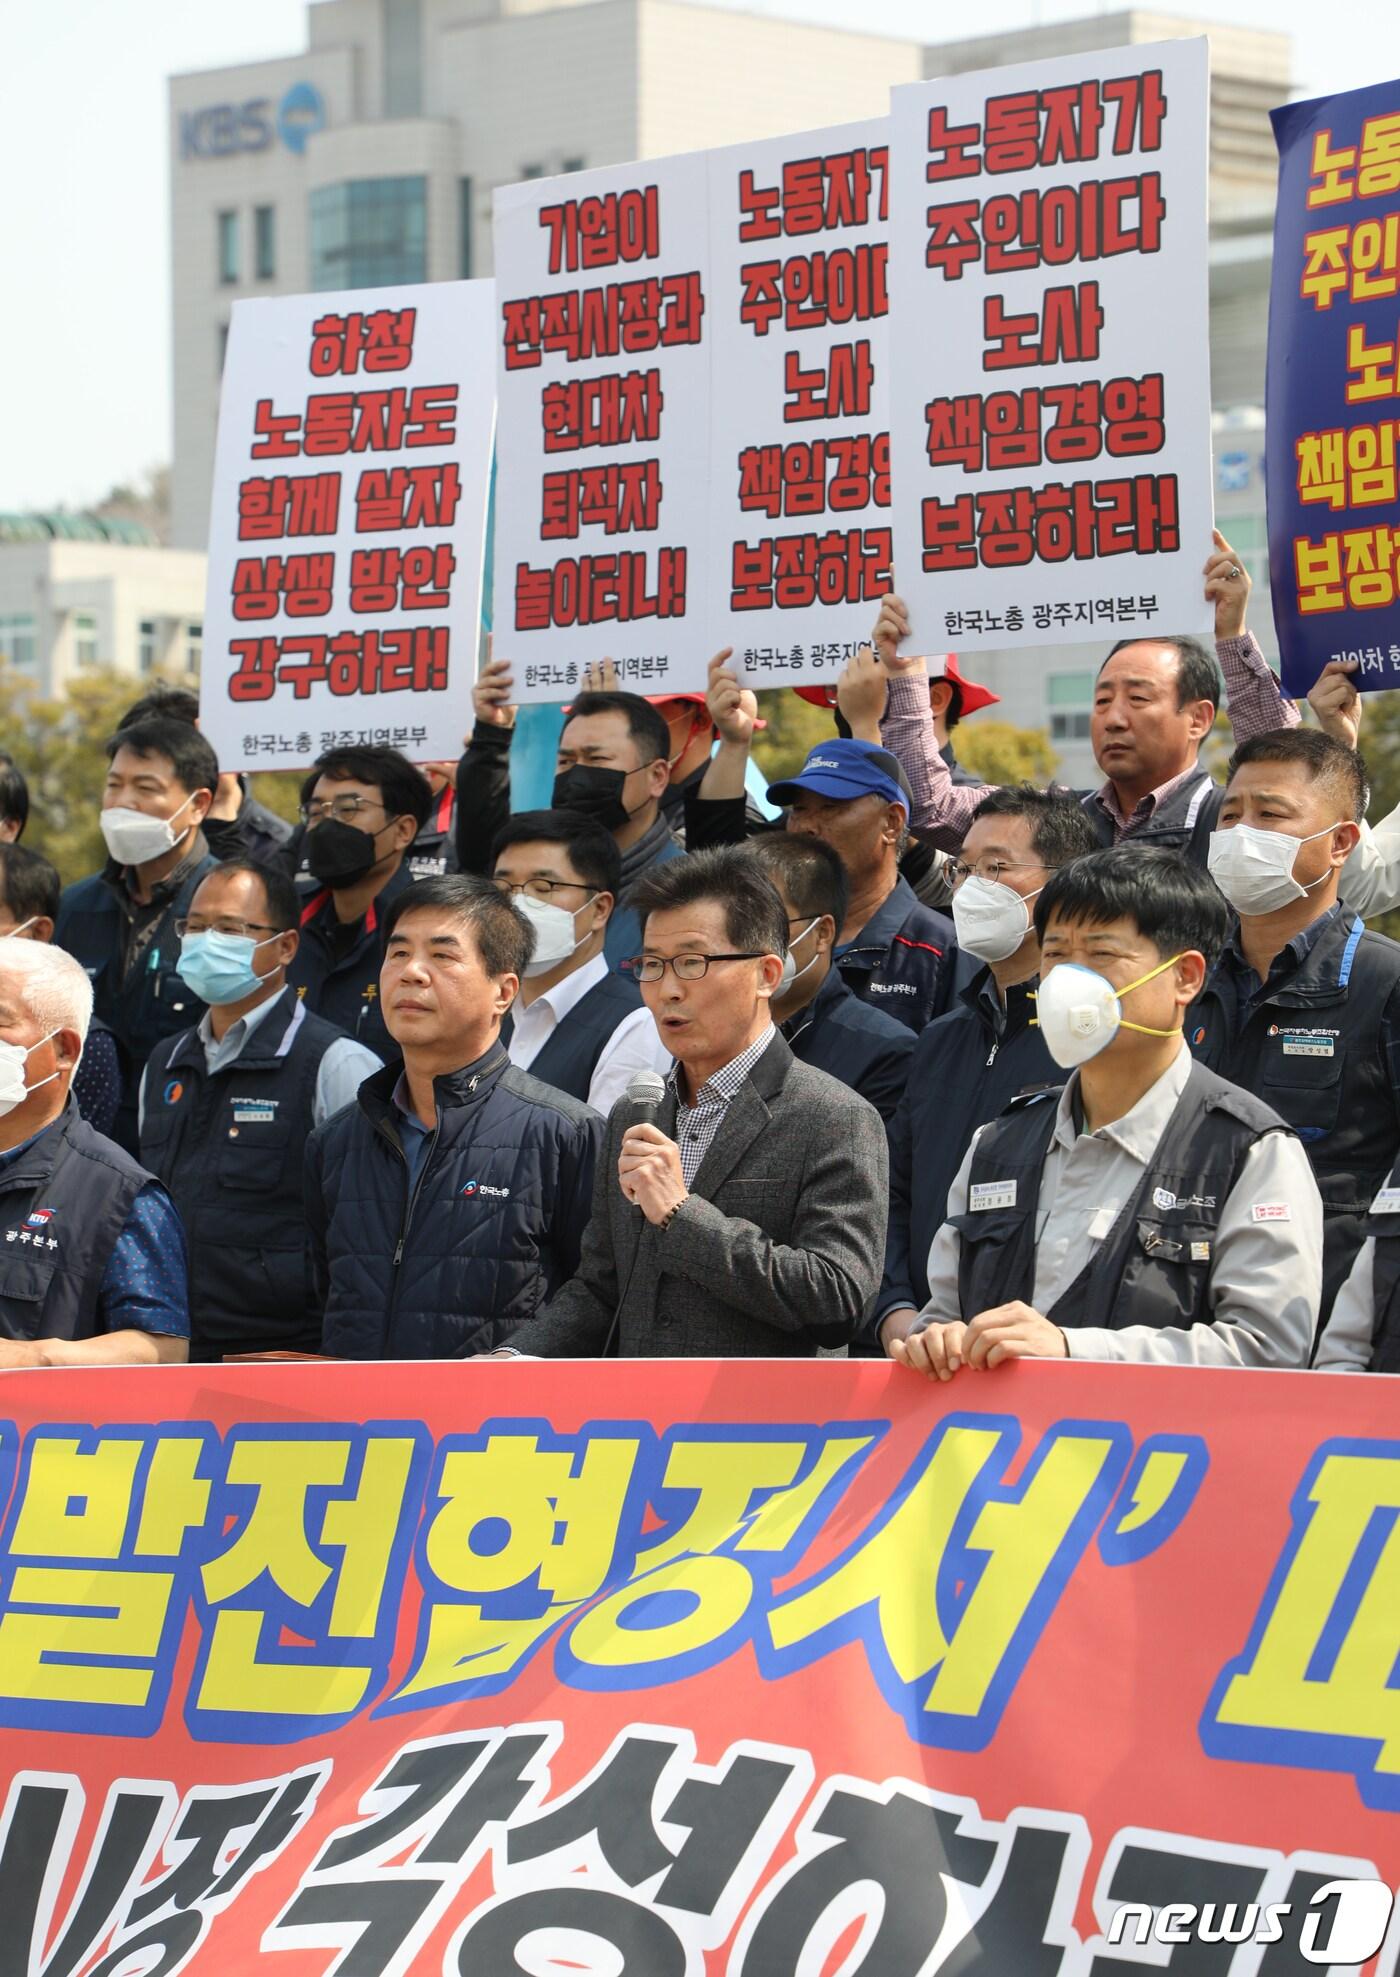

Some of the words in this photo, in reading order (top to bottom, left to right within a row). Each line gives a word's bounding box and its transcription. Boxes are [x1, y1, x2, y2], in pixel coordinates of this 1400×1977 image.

[180, 97, 273, 161] KBS
[926, 68, 1167, 184] 노동자가
[539, 184, 660, 275] 기업이
[925, 170, 1166, 282] 주인이다
[309, 308, 416, 377] 하청
[502, 270, 704, 371] 전직시장과
[982, 280, 1105, 372] 노사
[1345, 317, 1400, 405] 노
[251, 384, 459, 460] 노동자도
[541, 368, 664, 454] 현대차
[783, 339, 874, 423] 노사
[924, 372, 1166, 474] 책임경영
[238, 472, 341, 541] 함께
[355, 463, 461, 533] 살자
[540, 458, 663, 541] 퇴직자
[1295, 419, 1400, 511] 책임
[921, 473, 1181, 573] 보장하라!
[231, 552, 335, 621] 상생
[350, 544, 456, 614] 방안
[515, 546, 687, 631] 놀이터냐!
[1293, 520, 1400, 616] 보장
[744, 645, 805, 672] 한국노총
[810, 639, 881, 668] 광주지
[944, 605, 1025, 637] 한국노총
[1032, 594, 1160, 628] 광주지역본부
[228, 626, 450, 702] 강구하라!
[525, 661, 579, 687] 한국노총
[583, 655, 669, 681] 지역본부
[242, 731, 313, 756] 한국노총
[480, 1185, 510, 1197] 한국노총
[5, 1230, 59, 1251] 광주본부
